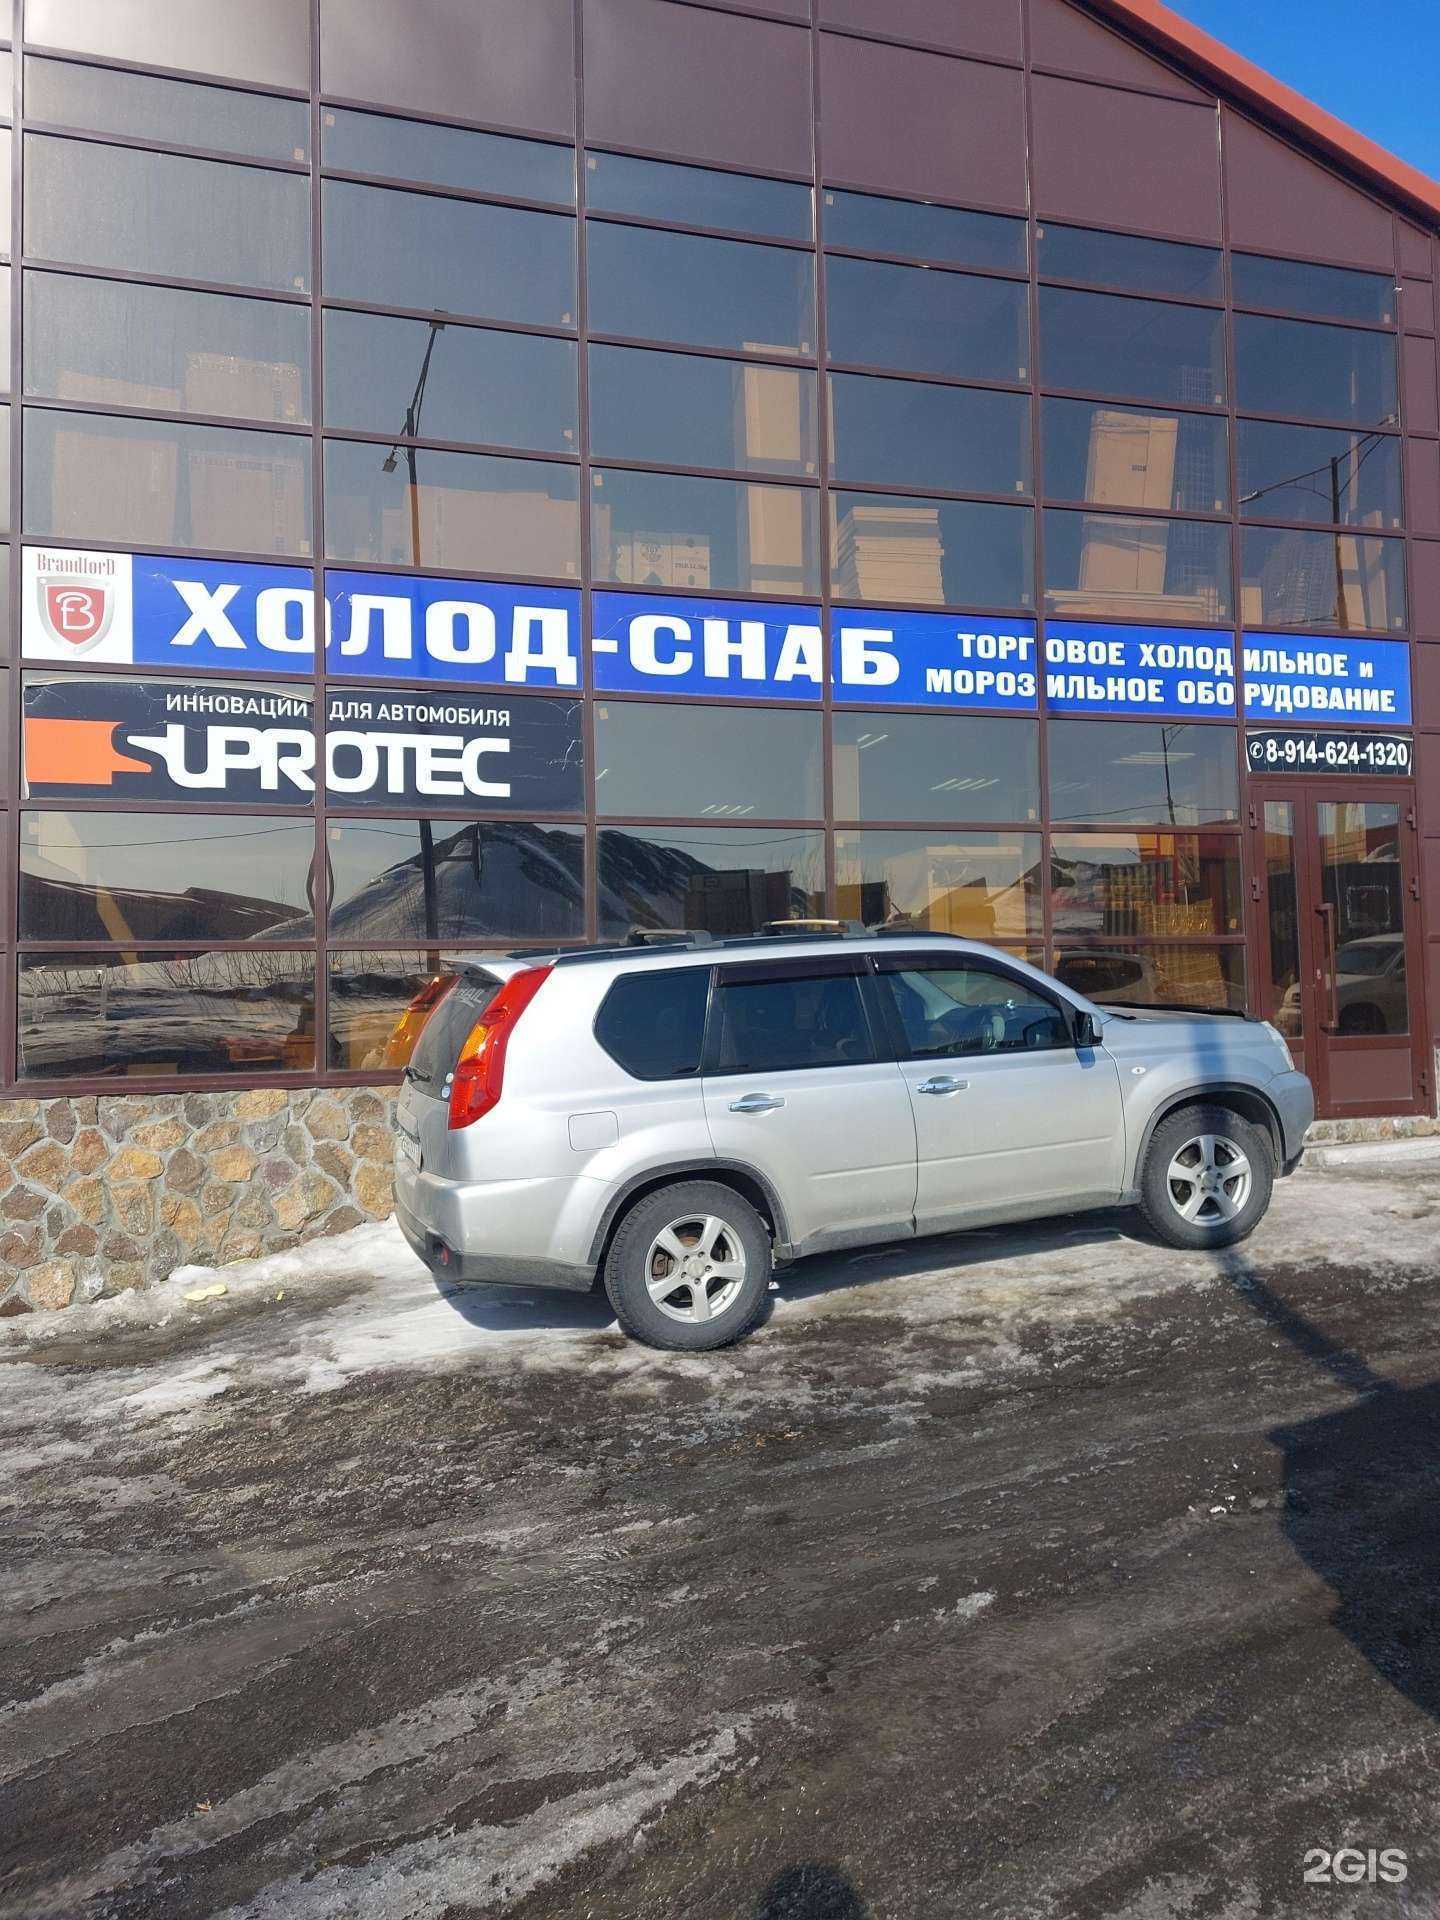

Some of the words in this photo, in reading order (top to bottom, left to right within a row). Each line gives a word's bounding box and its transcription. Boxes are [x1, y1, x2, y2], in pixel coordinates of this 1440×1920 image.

[957, 633, 1125, 665] ТОРГОВОЕ
[1139, 643, 1349, 677] ХОЛОДИЛЬНОЕ
[166, 693, 308, 718] ИННОВАЦИИ
[329, 700, 373, 720] ДЛЯ
[377, 703, 511, 727] АВТОМОБИЛЯ
[925, 668, 1165, 702] МОРОЗИЛЬНОЕ
[1177, 680, 1396, 713] ОБОРУДОВАНИЕ
[1266, 738, 1408, 766] 8-914-624-1320
